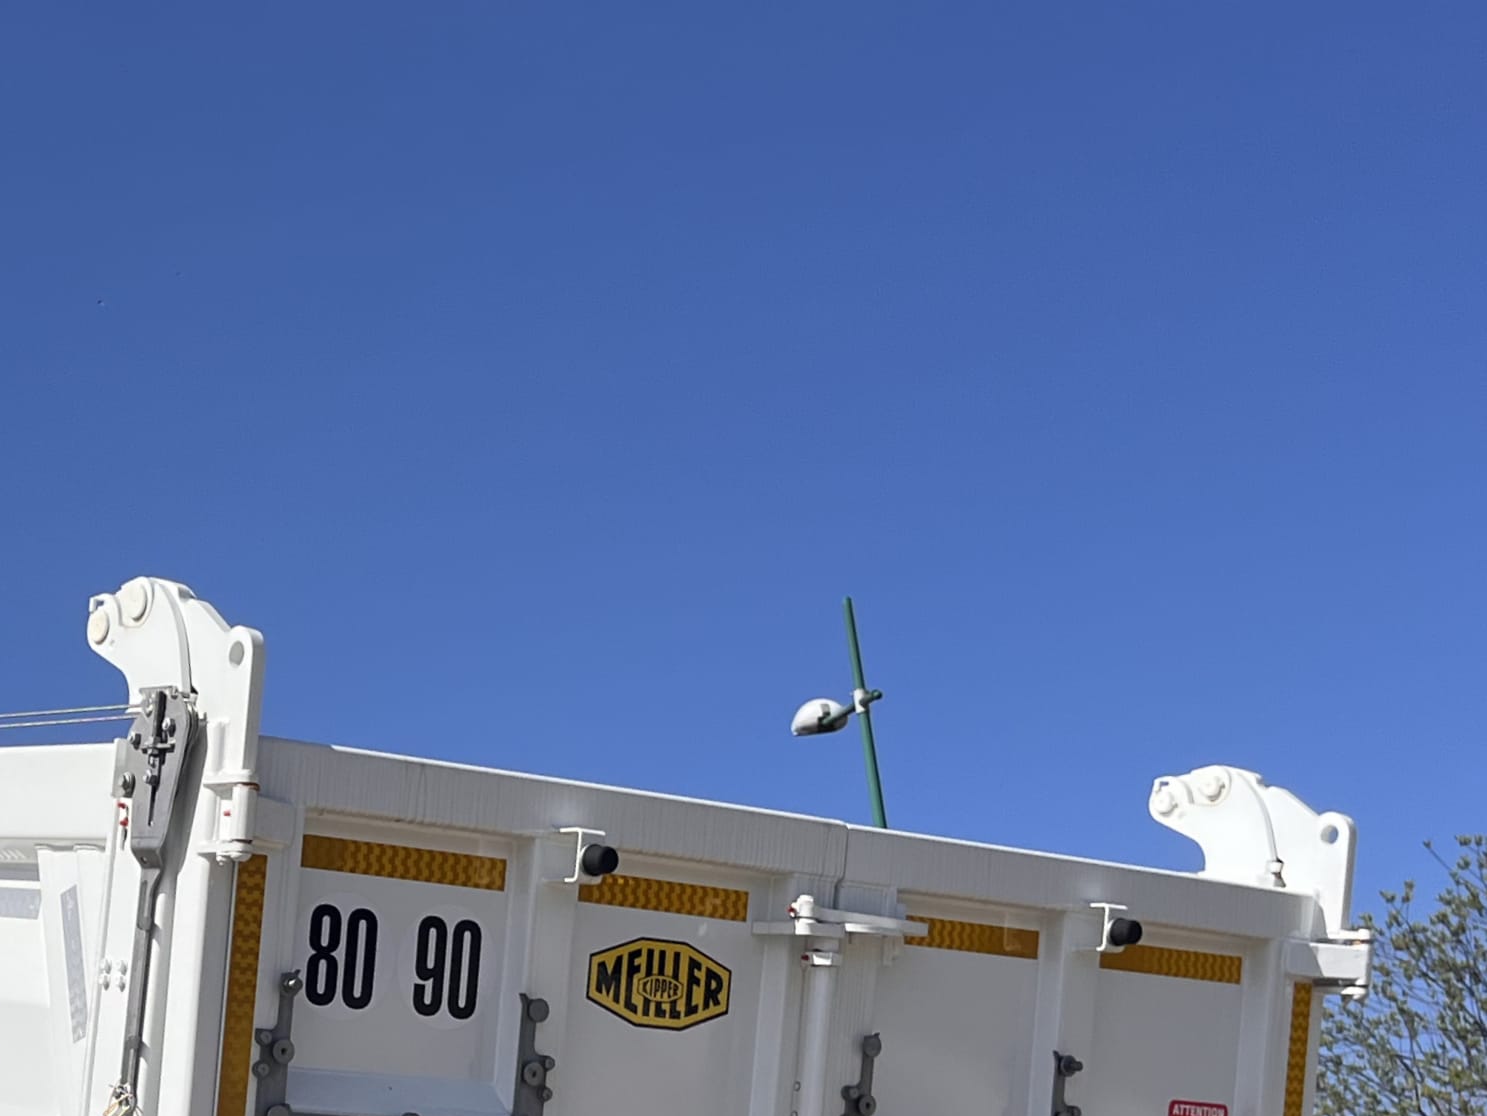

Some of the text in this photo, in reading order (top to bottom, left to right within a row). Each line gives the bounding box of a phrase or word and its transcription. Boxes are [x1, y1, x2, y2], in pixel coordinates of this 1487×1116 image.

[305, 903, 482, 1020] 80 90
[595, 947, 724, 1020] MEILLER
[642, 977, 679, 999] KIPPER
